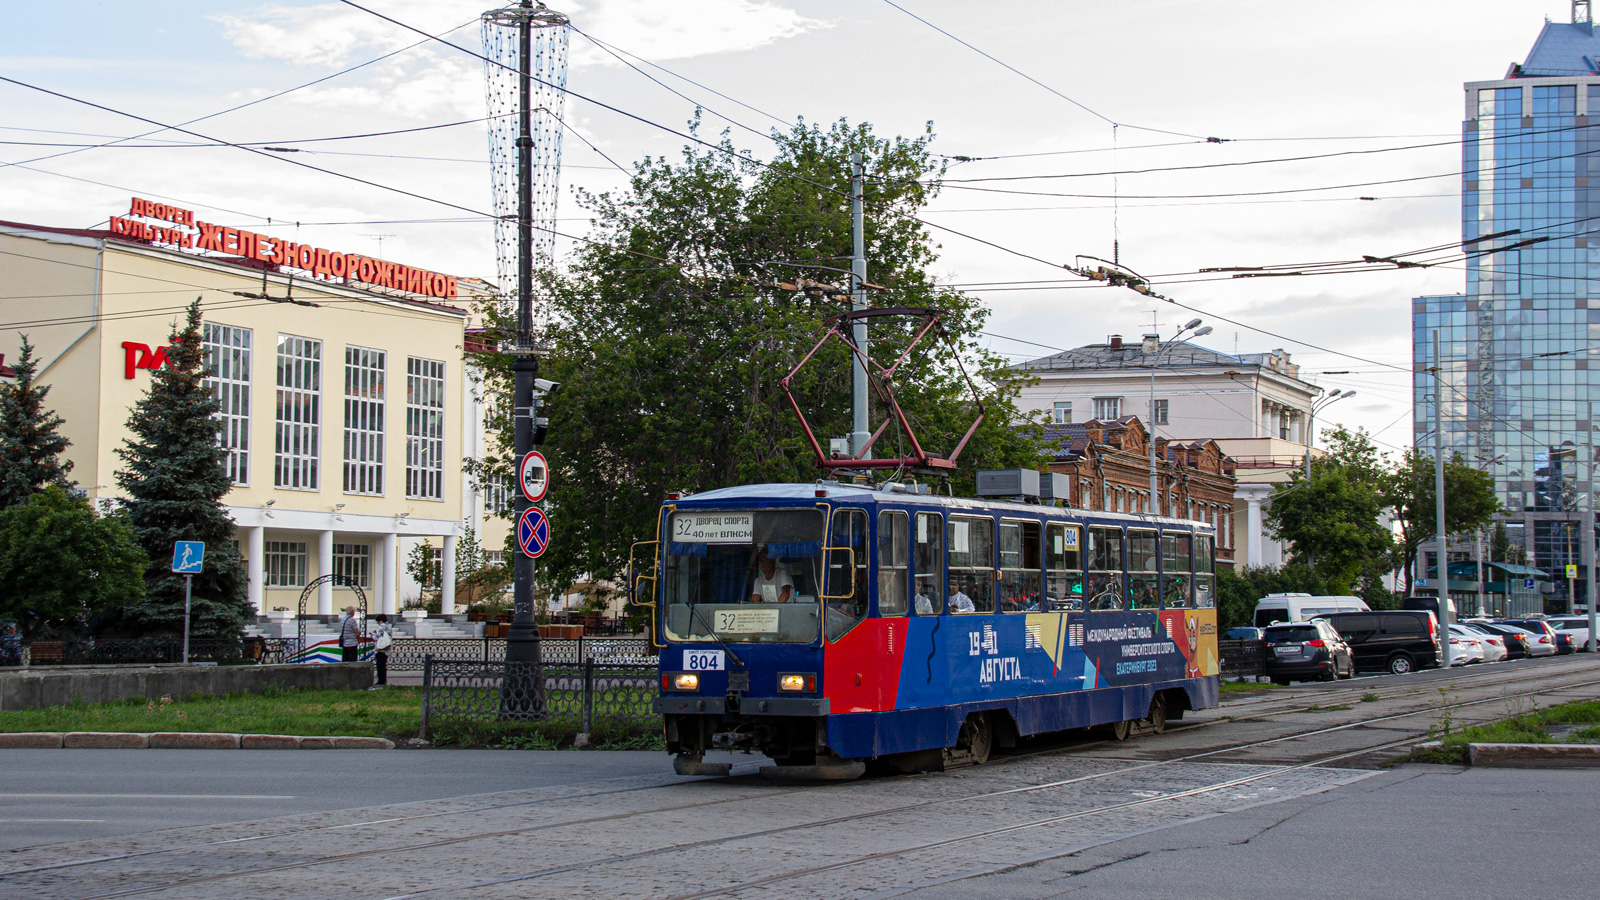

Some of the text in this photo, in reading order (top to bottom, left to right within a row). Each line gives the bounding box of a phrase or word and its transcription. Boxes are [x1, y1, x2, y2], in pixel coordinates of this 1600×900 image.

[130, 197, 194, 229] ДВОРЕЦ
[110, 216, 193, 249] КУЛЬТУРЫ
[196, 220, 458, 300] ЖЕЛЕЗНОДОРОЖНИКОВ
[676, 518, 692, 536] 32
[692, 530, 704, 538] 40
[720, 530, 752, 538] ВЛКСМ
[1065, 529, 1076, 545] 804
[720, 613, 736, 631] 32
[1086, 623, 1152, 643] МЕЖДУНАРОДНЫЙ ФЕСТИВАЛЬ
[1121, 643, 1161, 657] УНИВЕРСИТЕТСКОГО
[689, 654, 719, 670] 804
[979, 656, 1022, 683] АВГУСТА
[1116, 660, 1147, 675] ЕКАТЕРИНБУРГ
